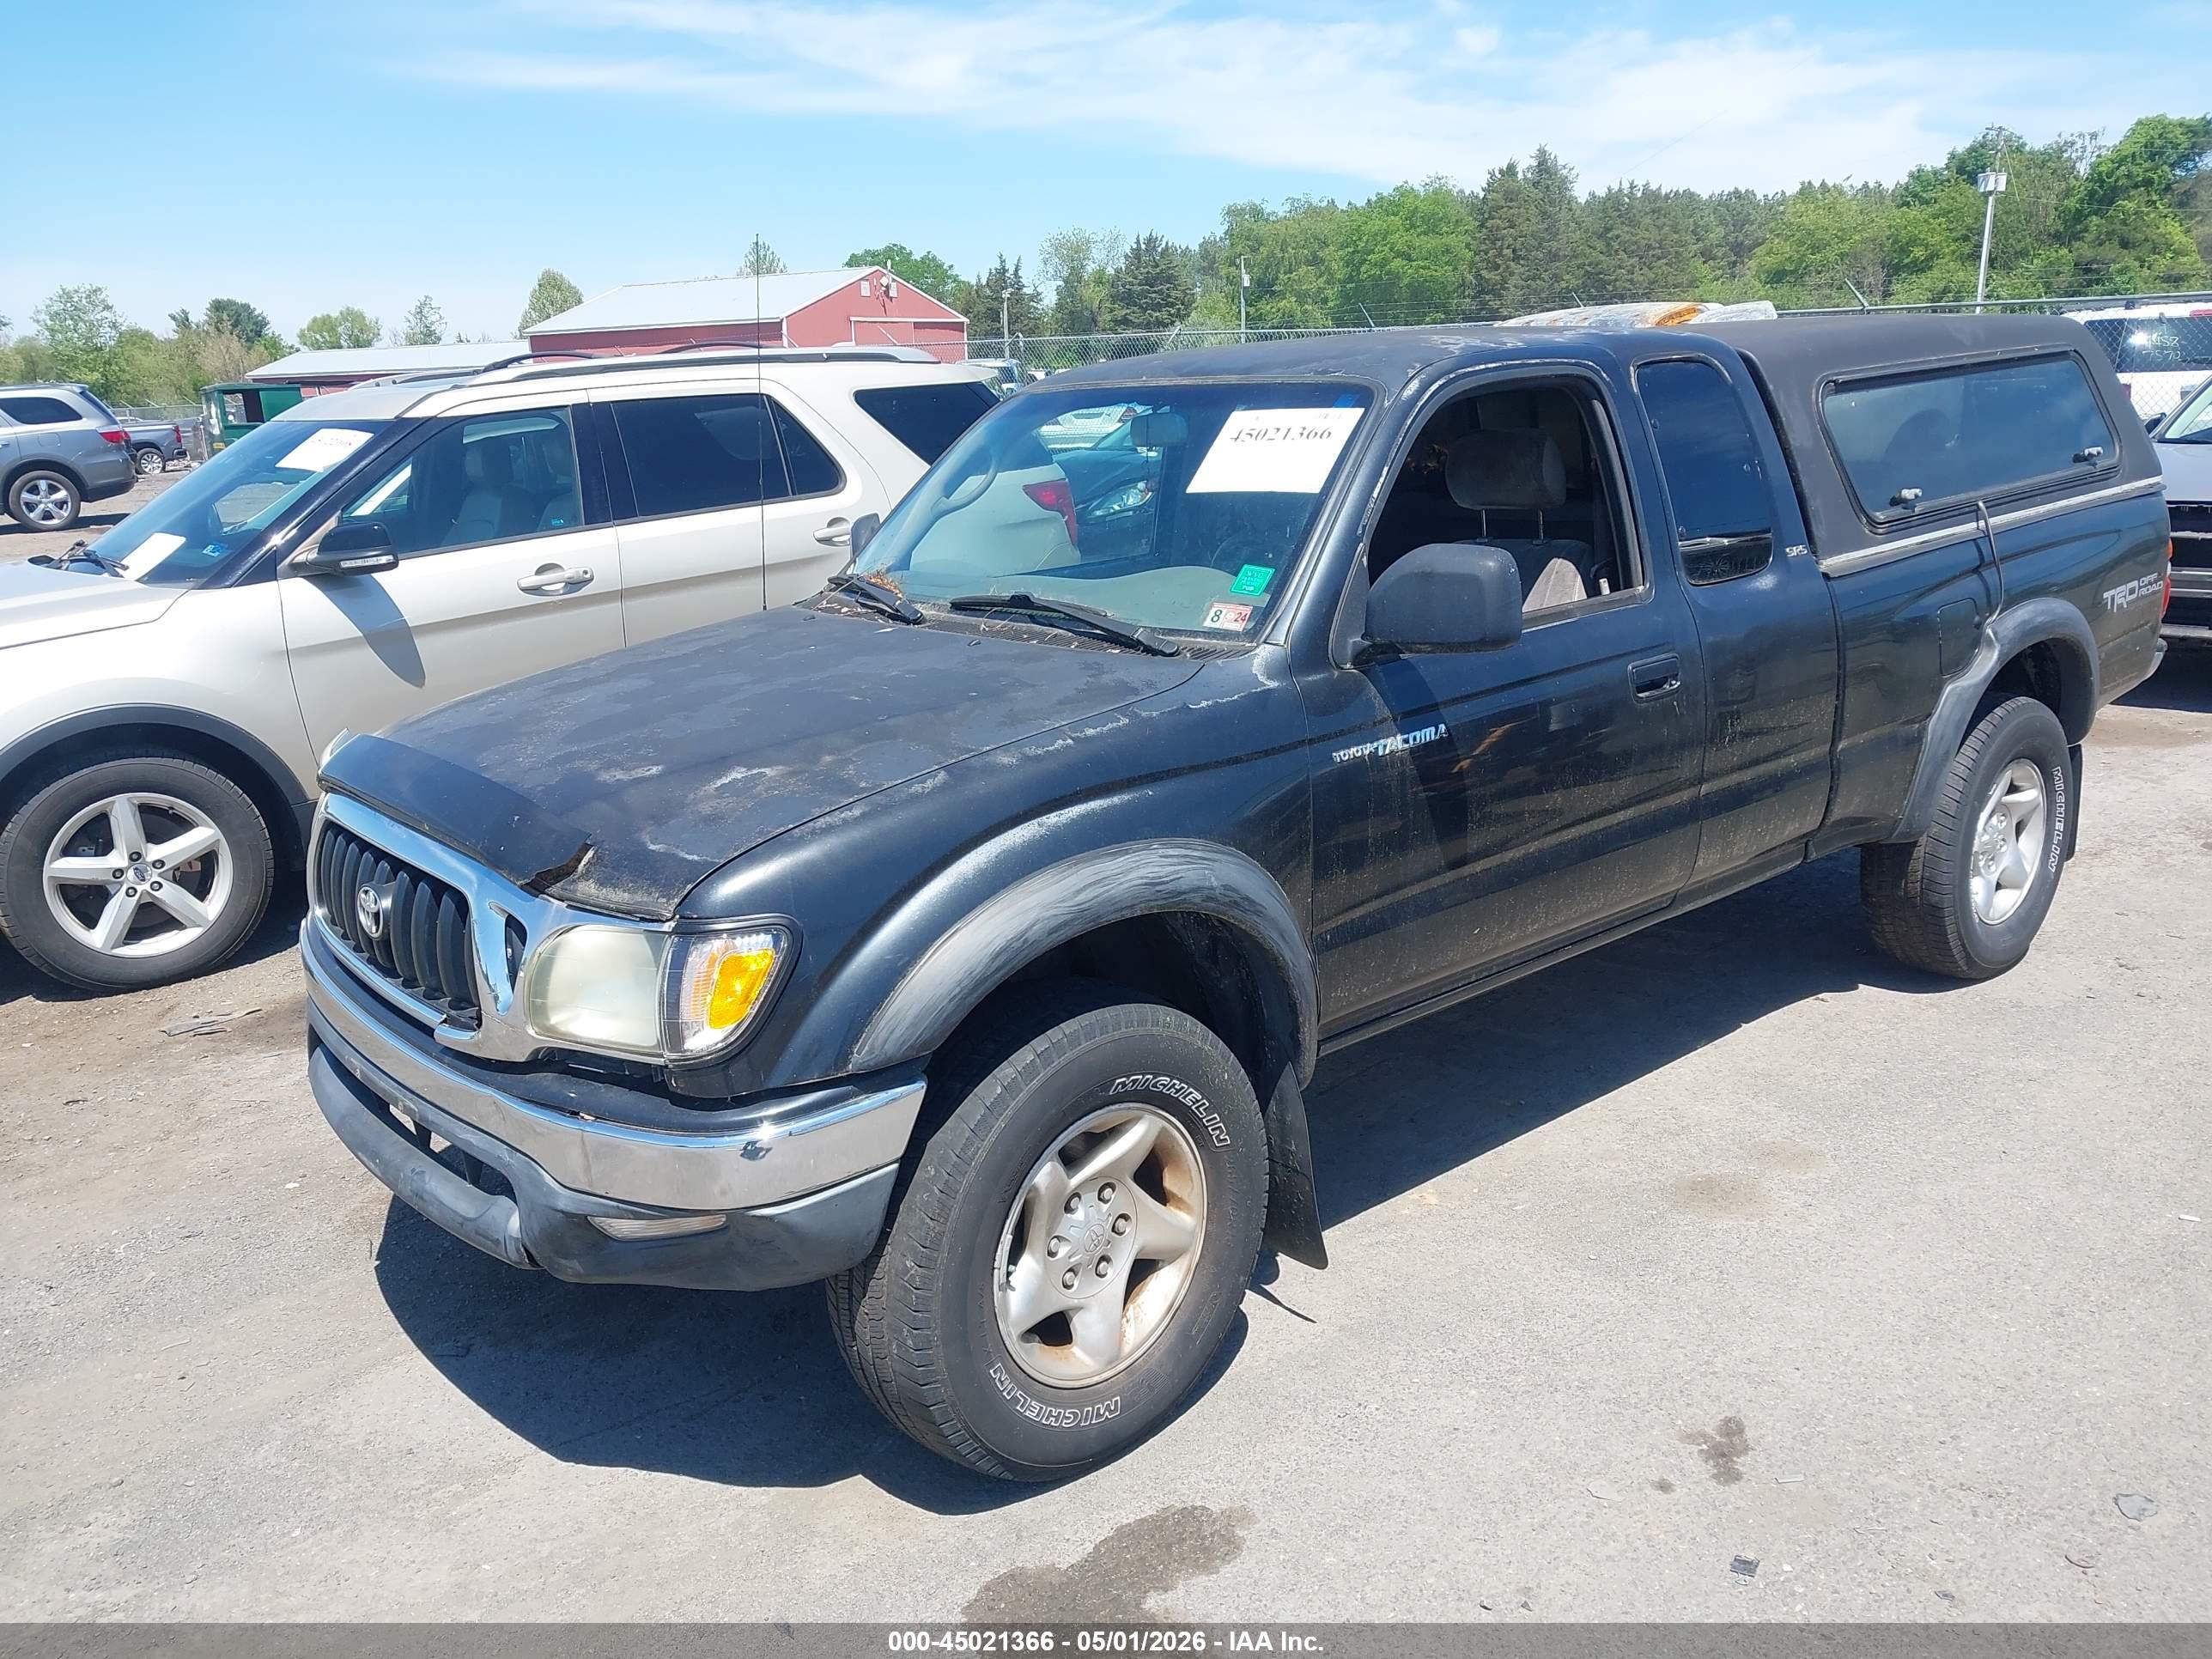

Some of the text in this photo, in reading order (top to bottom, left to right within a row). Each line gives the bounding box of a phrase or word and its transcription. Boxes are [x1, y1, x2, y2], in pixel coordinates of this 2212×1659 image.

[1230, 426, 1333, 442] 45021366
[1786, 545, 1808, 557] SR5
[2138, 580, 2163, 597] ROAD
[2139, 573, 2158, 586] OFF
[2103, 580, 2139, 613] TRD
[1211, 609, 1248, 623] 8 24
[1333, 723, 1449, 763] TOYOTA TACOMA
[2048, 766, 2065, 873] MICHELIN
[1109, 1075, 1231, 1147] MICHELIN
[989, 1363, 1121, 1428] MICHELIN
